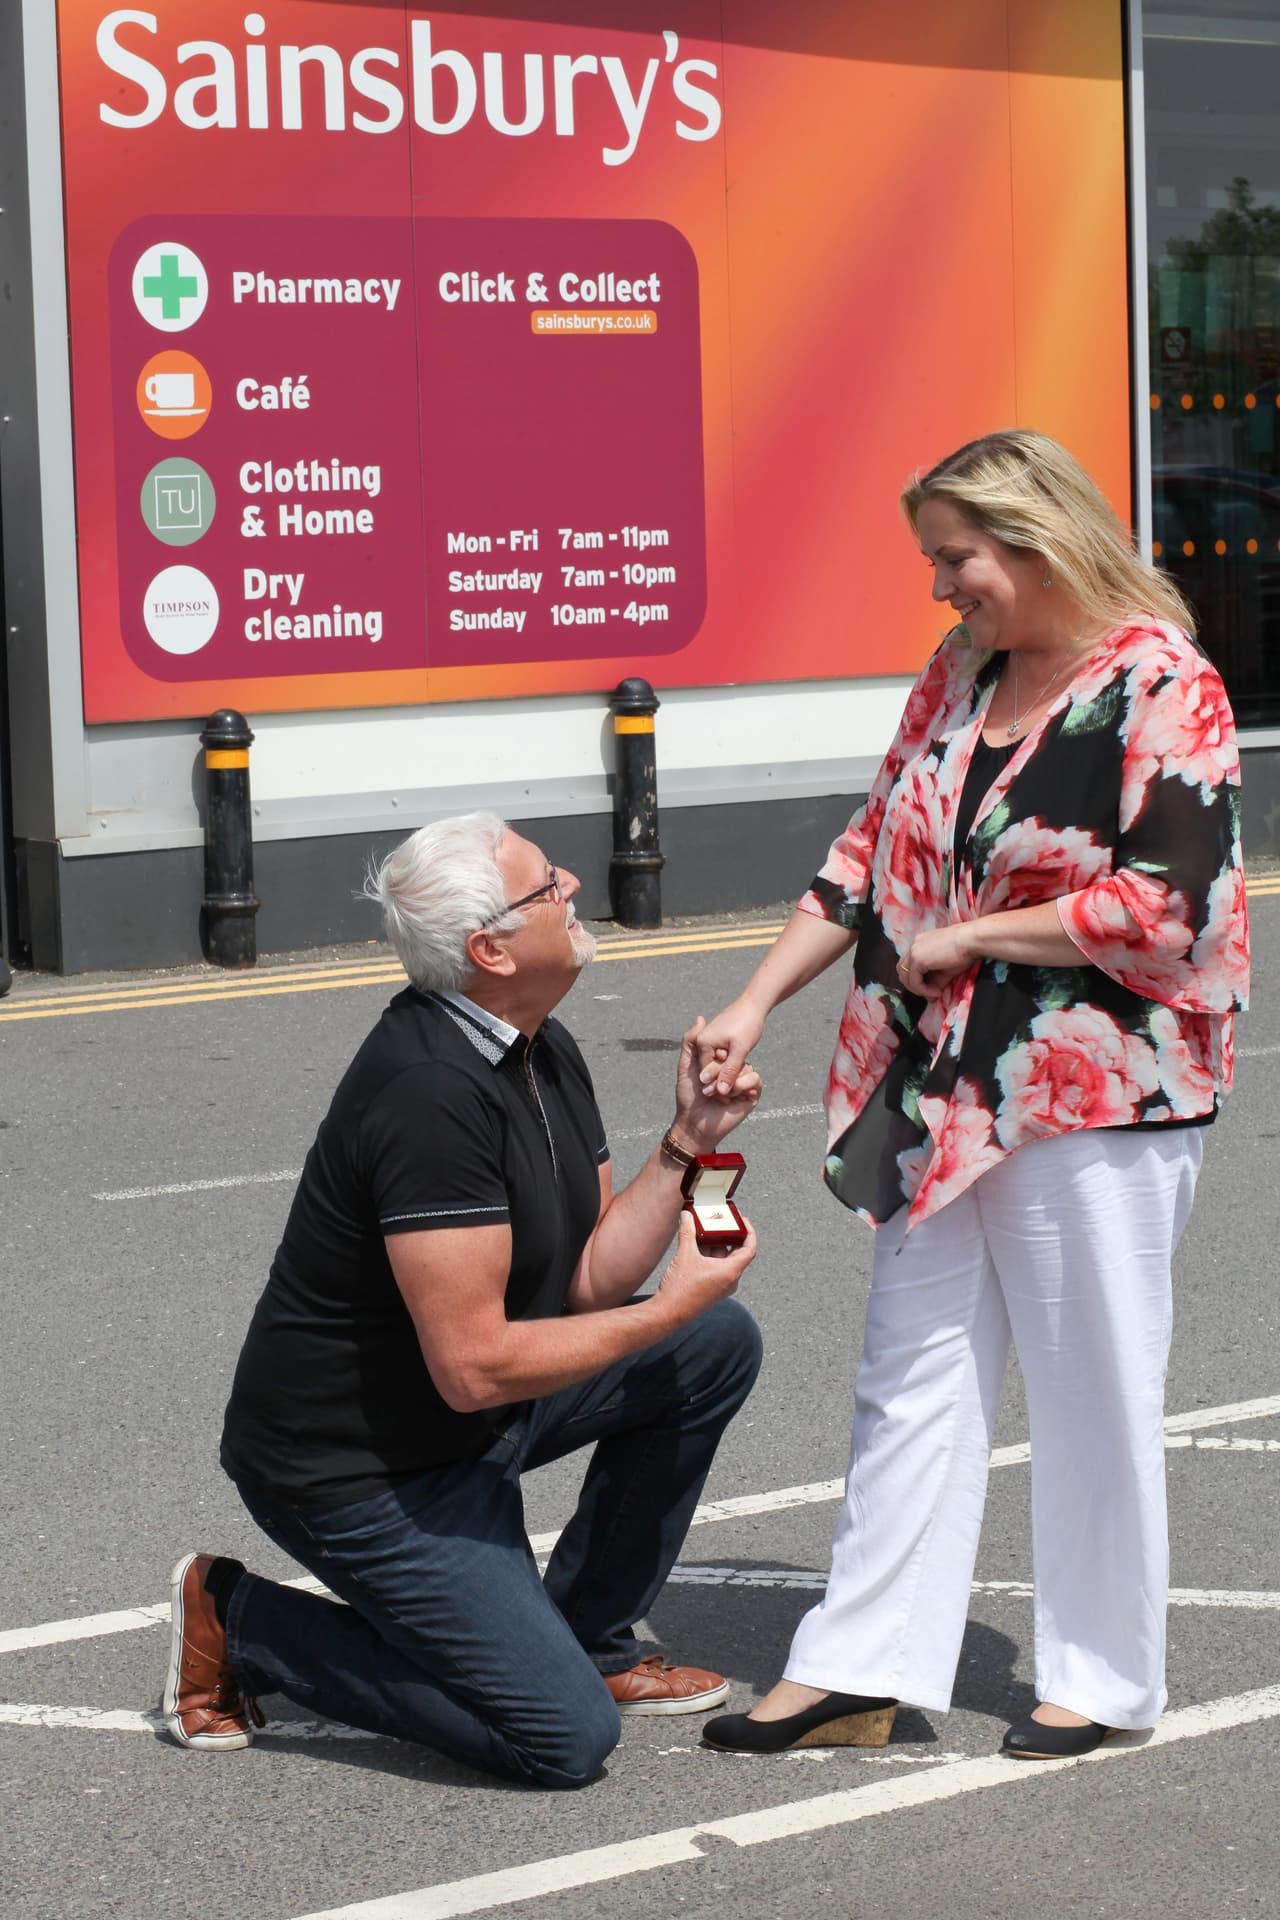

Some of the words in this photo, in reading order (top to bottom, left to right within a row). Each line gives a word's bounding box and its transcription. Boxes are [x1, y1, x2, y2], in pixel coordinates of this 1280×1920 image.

[232, 271, 401, 311] Pharmacy
[438, 271, 516, 303] Click
[525, 272, 549, 303] &
[558, 272, 661, 303] Collect
[536, 313, 652, 332] sainsburys.co.uk
[236, 375, 311, 411] Café
[239, 458, 381, 498] Clothing
[161, 489, 195, 515] TU
[240, 505, 267, 538] &
[278, 504, 374, 536] Home
[447, 532, 492, 554] Mon
[510, 528, 539, 552] Fri
[558, 528, 604, 550] 7am
[621, 526, 669, 551] 11pm
[243, 568, 305, 606] Dry
[448, 568, 543, 594] Saturday
[560, 566, 605, 588] 7am
[622, 563, 676, 589] 10pm
[152, 601, 210, 614] TIMPSON
[244, 604, 384, 643] cleaning
[449, 607, 527, 633] Sunday
[550, 604, 606, 626] 10am
[623, 601, 669, 626] 4pm
